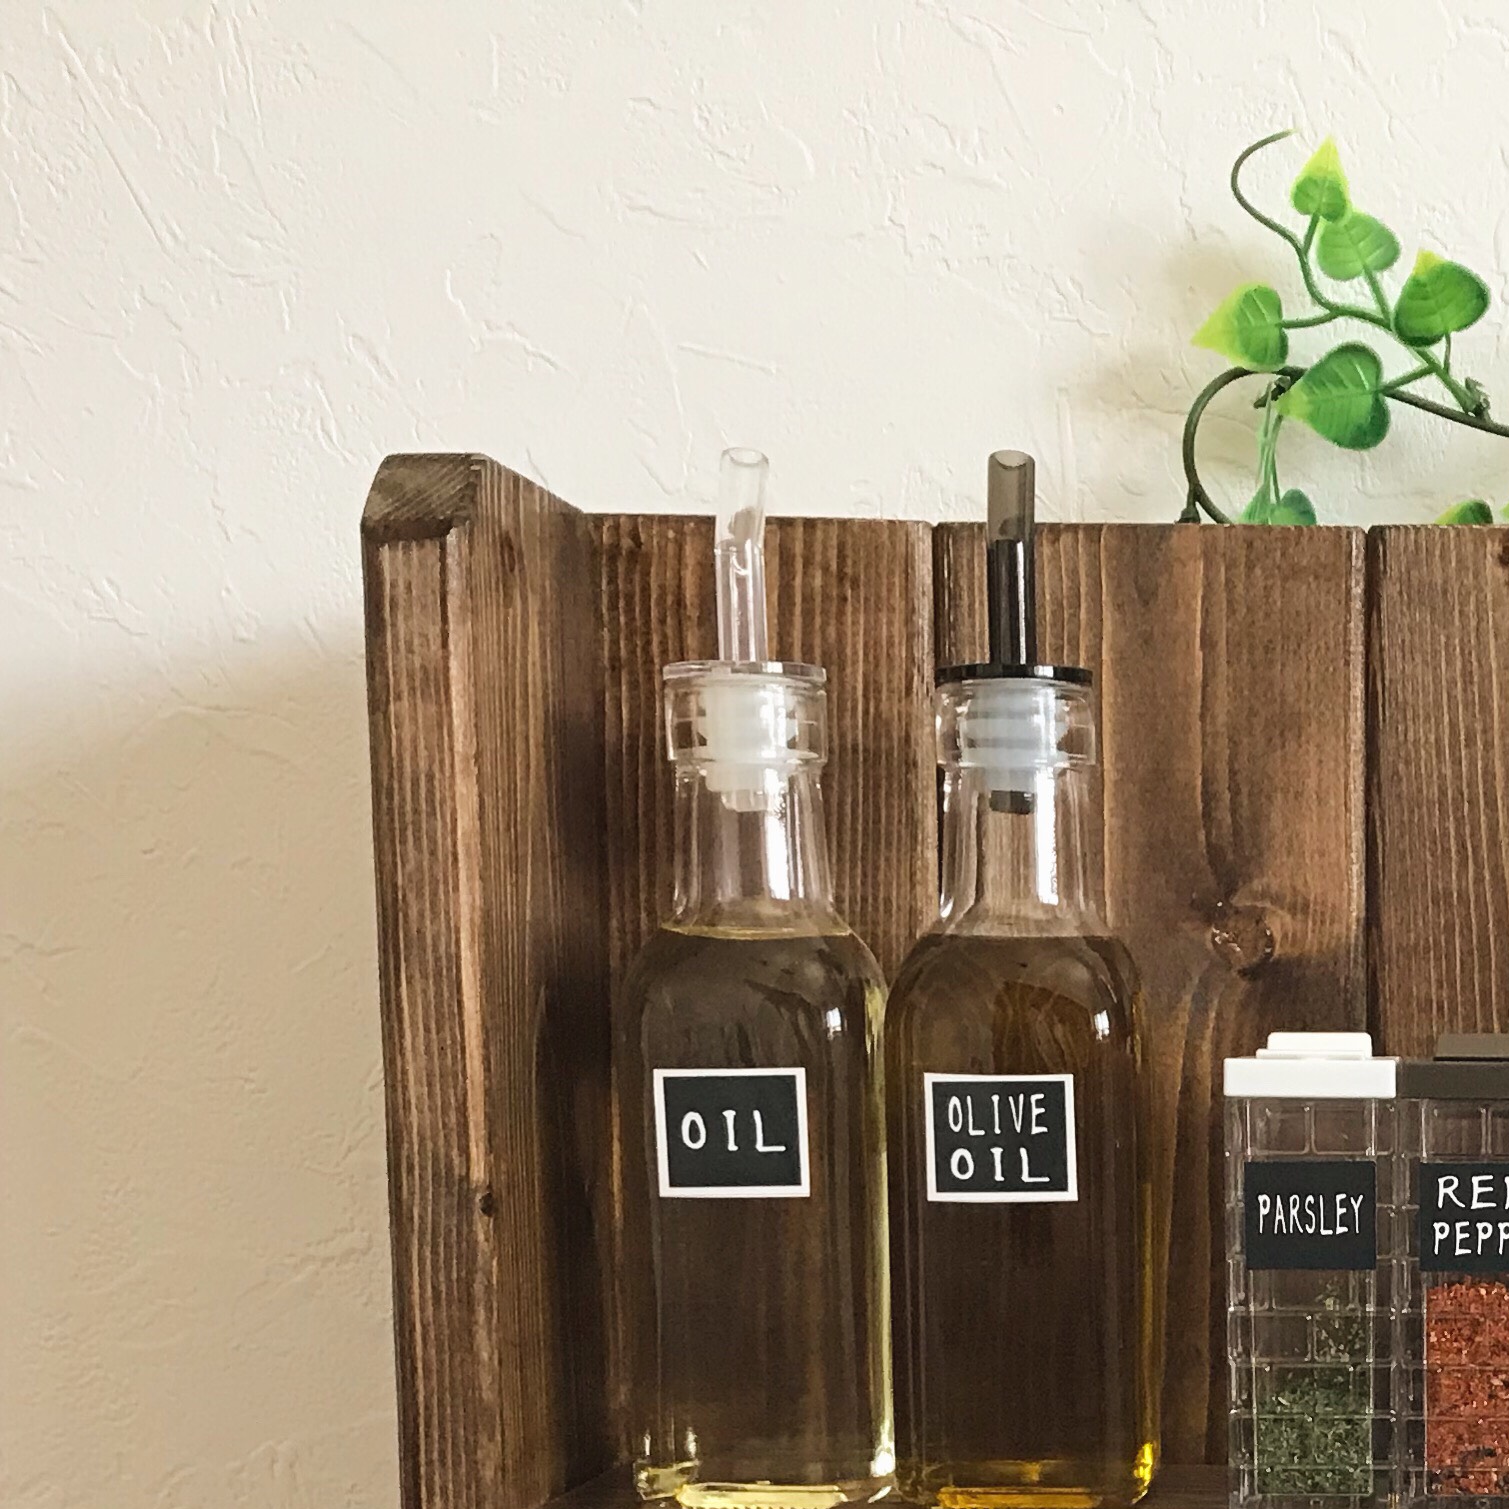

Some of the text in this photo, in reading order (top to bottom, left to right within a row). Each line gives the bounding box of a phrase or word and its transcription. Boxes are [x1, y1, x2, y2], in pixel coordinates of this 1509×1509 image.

[681, 1109, 787, 1153] OIL
[947, 1093, 1049, 1136] OLIVE
[950, 1147, 1050, 1183] OIL
[1257, 1193, 1365, 1236] PARSLEY
